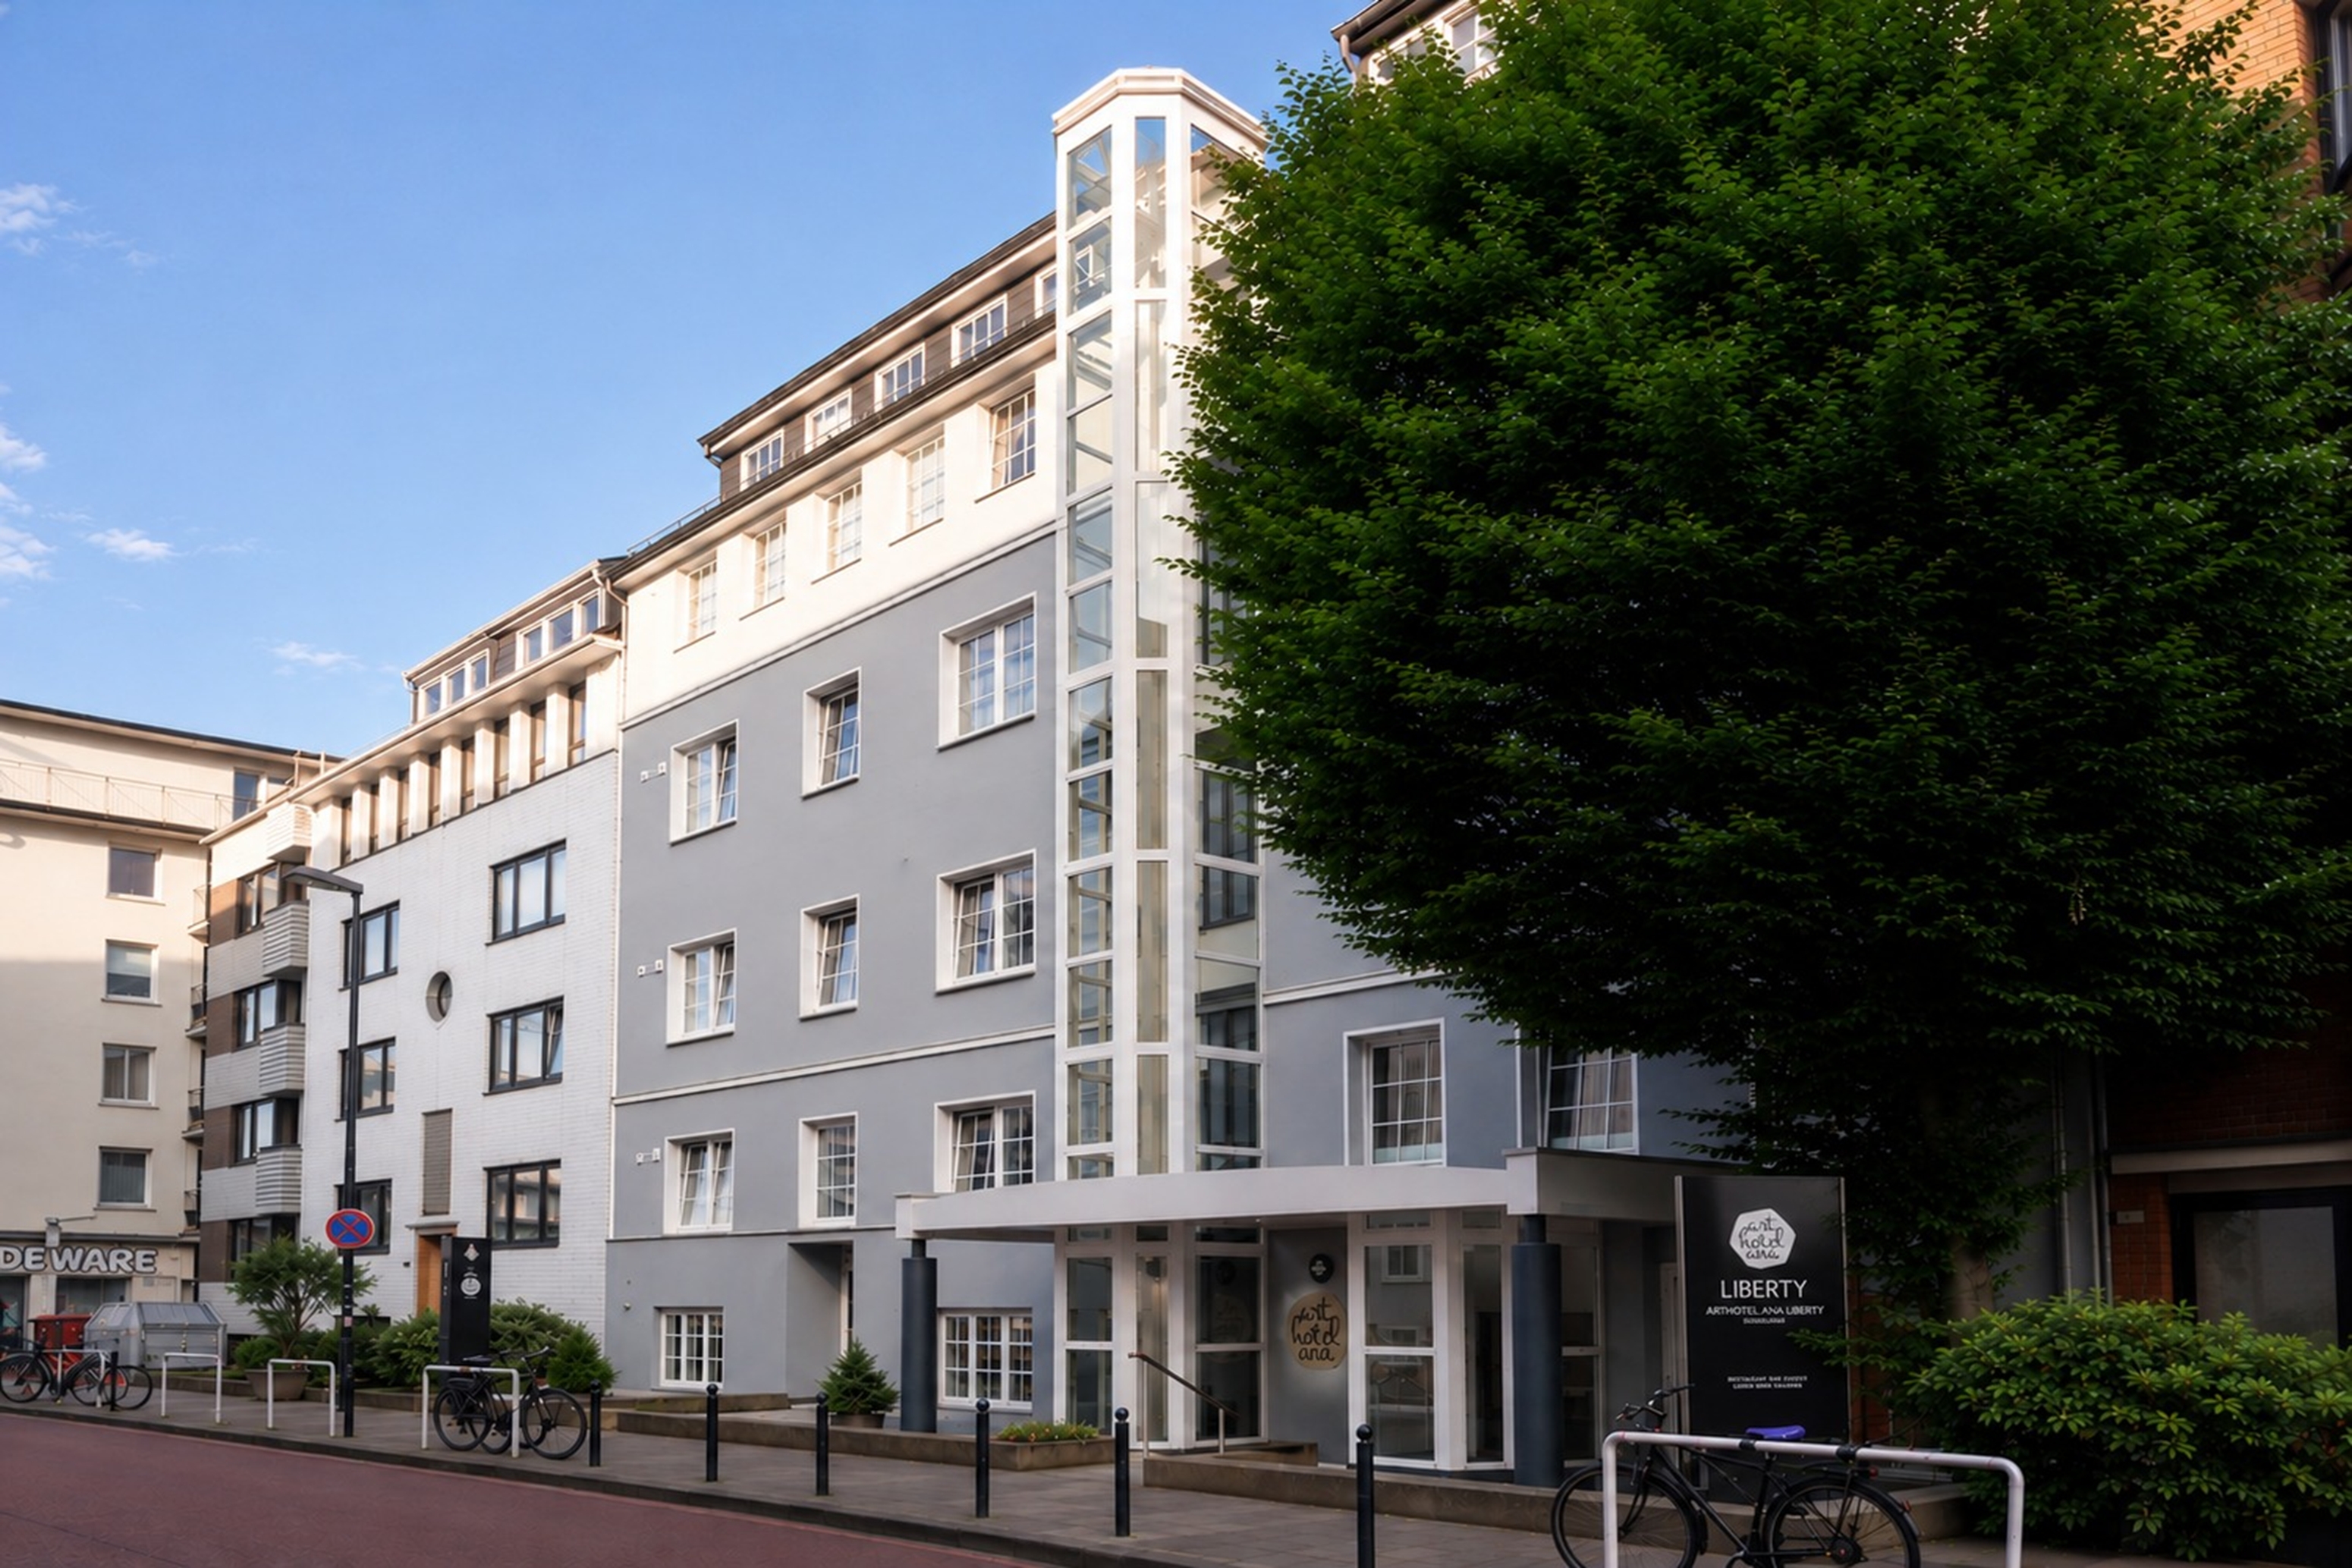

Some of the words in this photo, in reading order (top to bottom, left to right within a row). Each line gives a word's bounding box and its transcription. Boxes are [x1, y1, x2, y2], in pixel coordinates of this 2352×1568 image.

[50, 1246, 159, 1274] WARE
[1720, 1279, 1807, 1299] LIBERTY
[1298, 1347, 1335, 1362] ana
